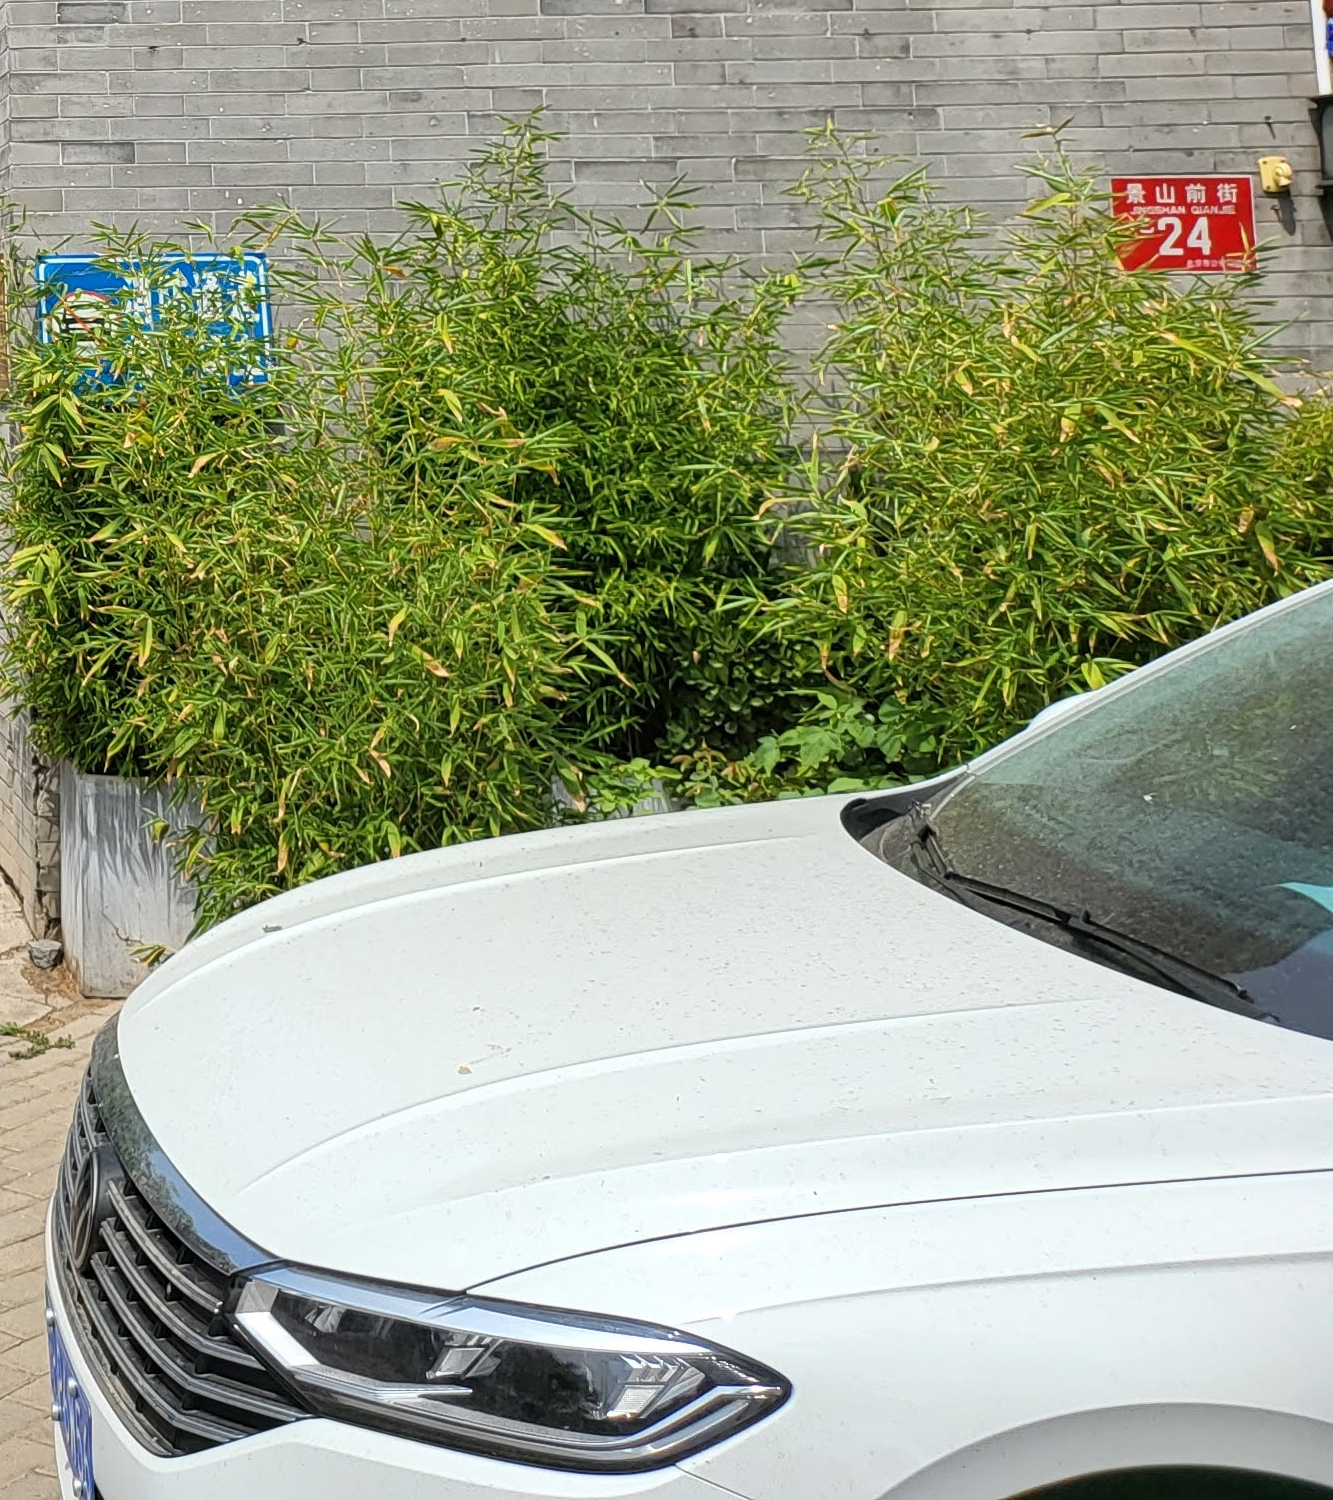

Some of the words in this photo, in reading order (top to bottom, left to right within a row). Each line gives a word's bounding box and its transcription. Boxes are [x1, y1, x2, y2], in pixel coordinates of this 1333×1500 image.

[1125, 182, 1238, 204] 景山前街
[1130, 205, 1186, 215] JINGSHAN
[1190, 205, 1236, 215] QIANJIE
